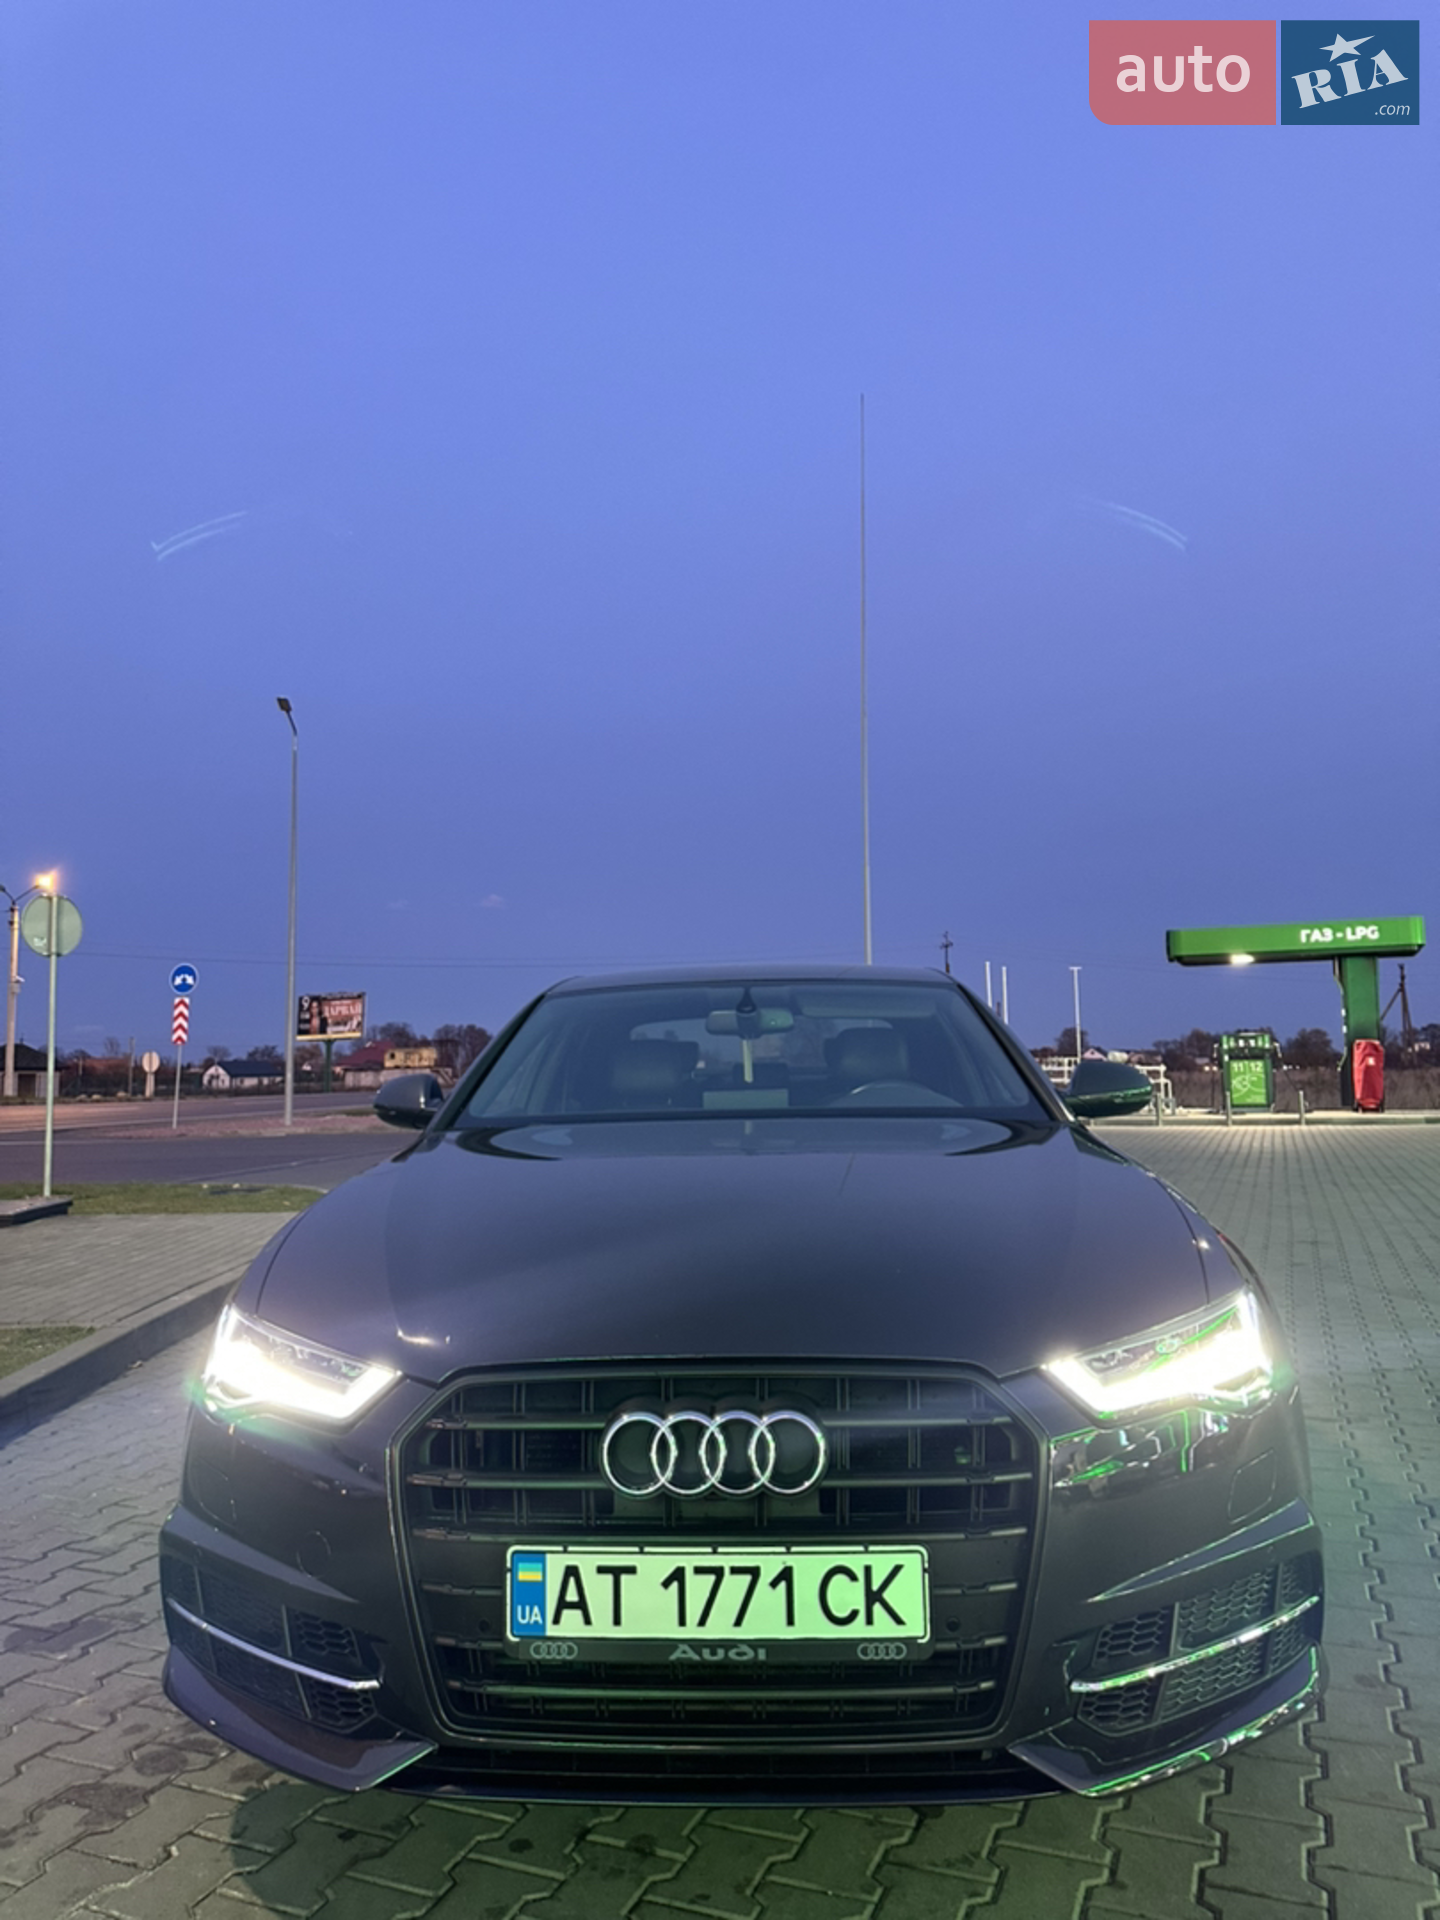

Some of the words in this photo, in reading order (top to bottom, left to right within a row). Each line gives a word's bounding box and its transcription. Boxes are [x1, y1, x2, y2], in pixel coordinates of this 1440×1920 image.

[1300, 927, 1334, 943] ГАЗ
[1346, 924, 1380, 941] LPG
[552, 1564, 638, 1626] AT
[660, 1565, 795, 1628] 1771
[818, 1564, 907, 1627] CK
[516, 1605, 543, 1625] UA
[668, 1644, 767, 1661] Audi
